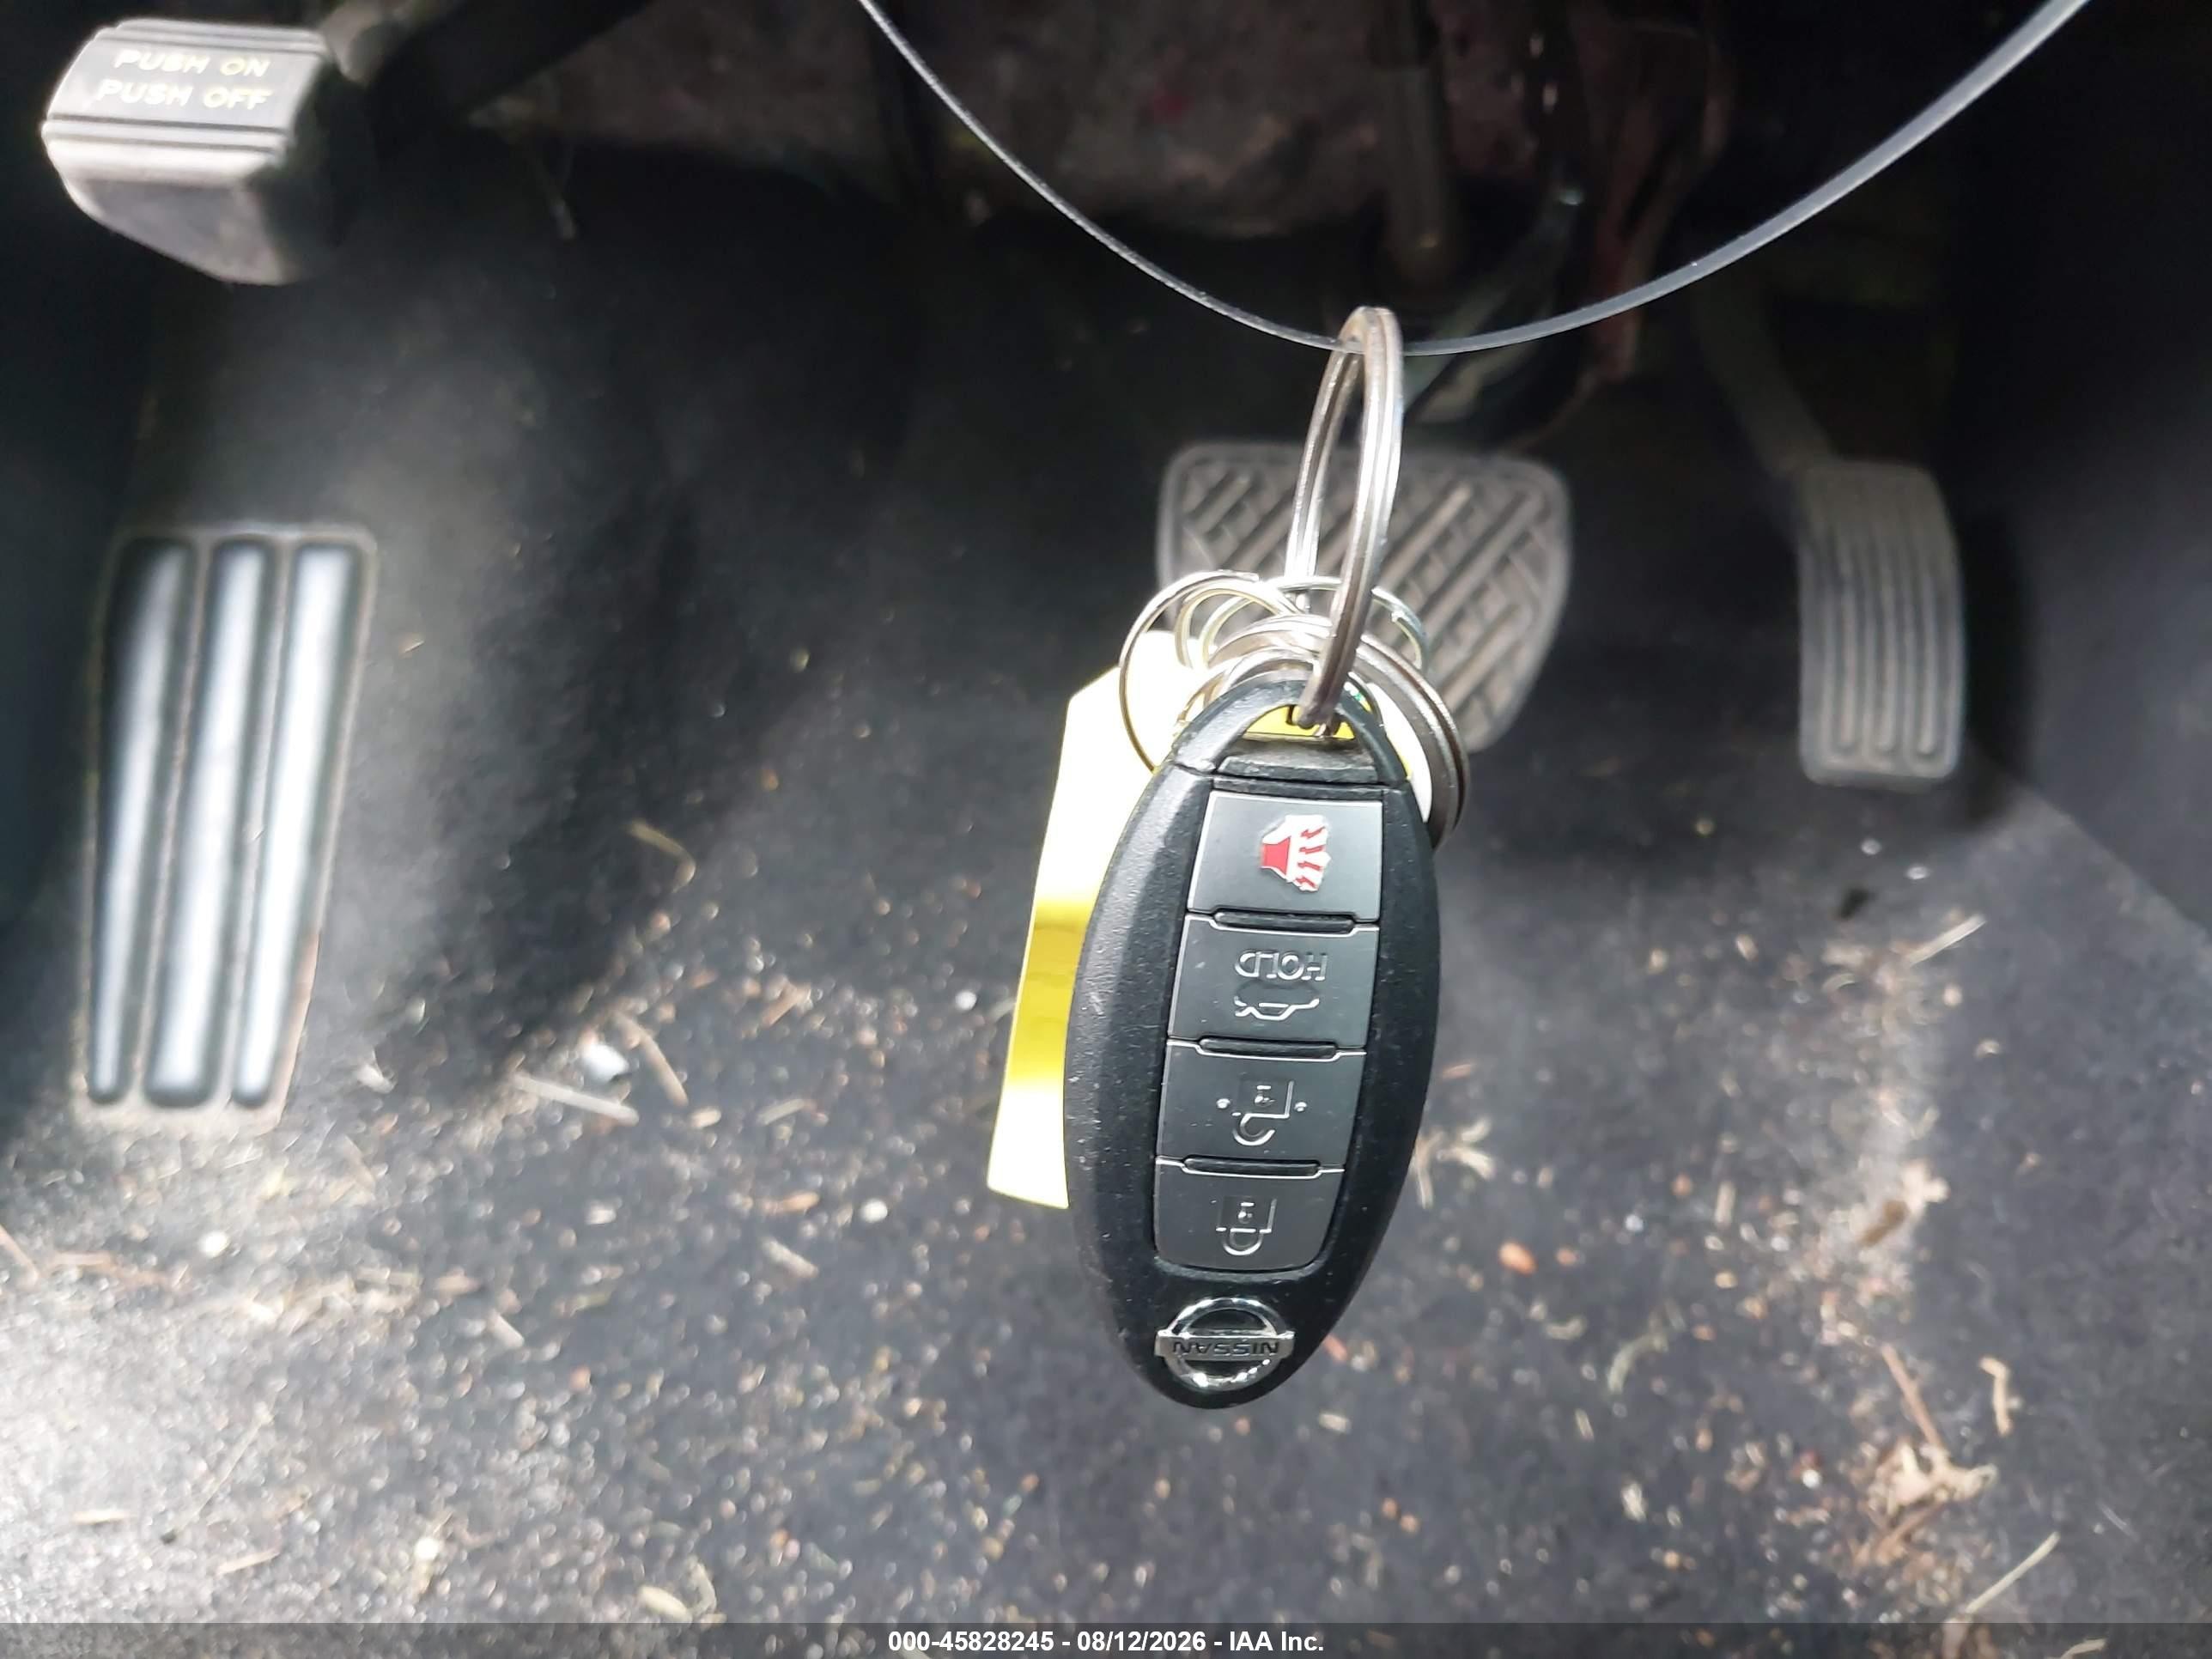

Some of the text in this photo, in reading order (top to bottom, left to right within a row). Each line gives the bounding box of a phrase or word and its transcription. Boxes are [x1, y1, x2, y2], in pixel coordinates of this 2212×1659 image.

[114, 49, 270, 77] PUSH ON
[95, 78, 275, 110] PUSH OFF
[1234, 949, 1328, 981] HOLD
[1171, 1340, 1280, 1356] NISSAN
